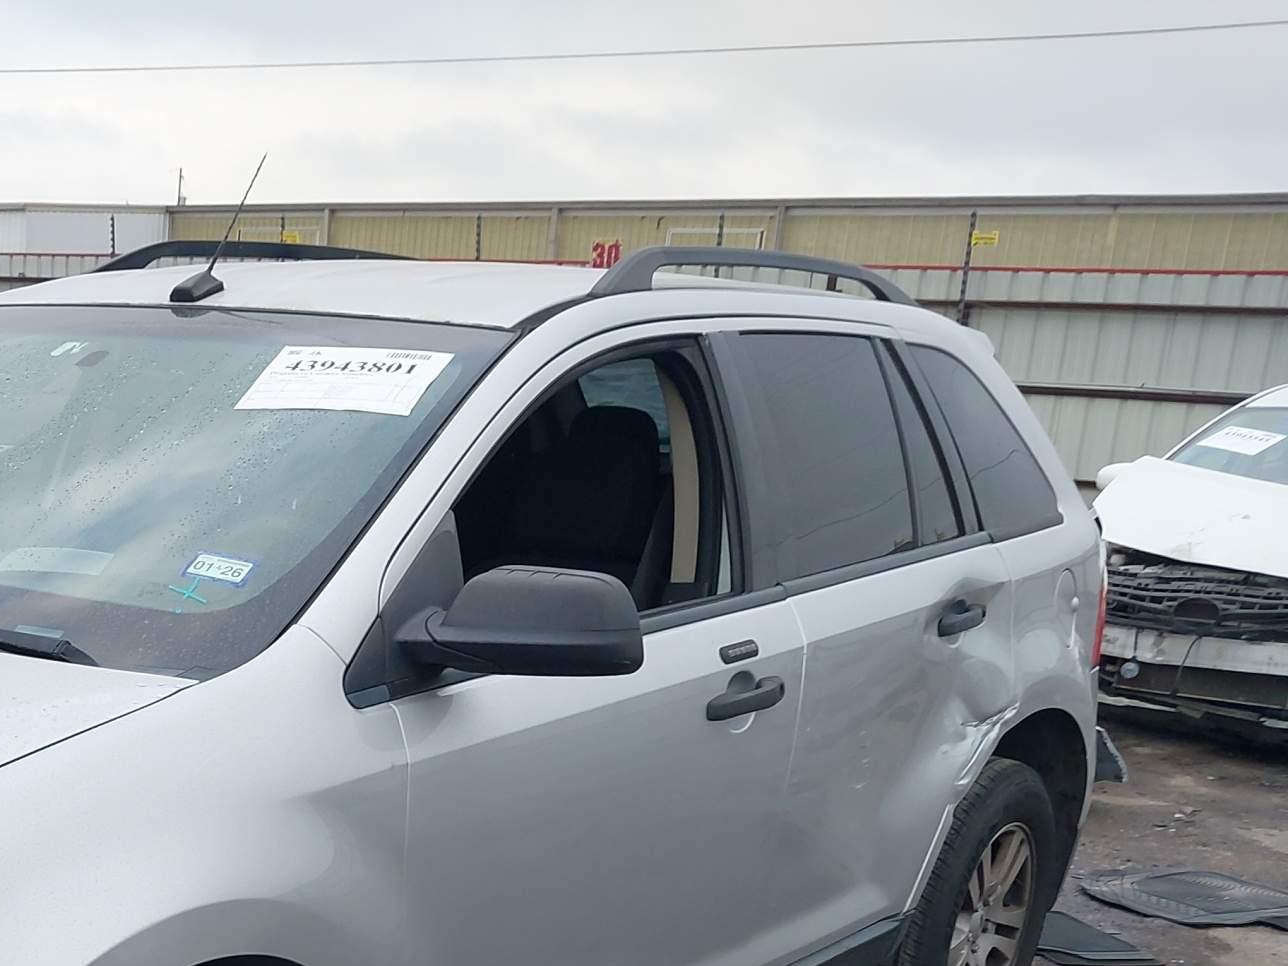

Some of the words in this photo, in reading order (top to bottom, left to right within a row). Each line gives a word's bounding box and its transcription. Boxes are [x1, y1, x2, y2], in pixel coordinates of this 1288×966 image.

[592, 241, 621, 268] 30
[285, 359, 418, 375] 43943801
[193, 560, 215, 572] 01
[220, 565, 244, 578] 26
